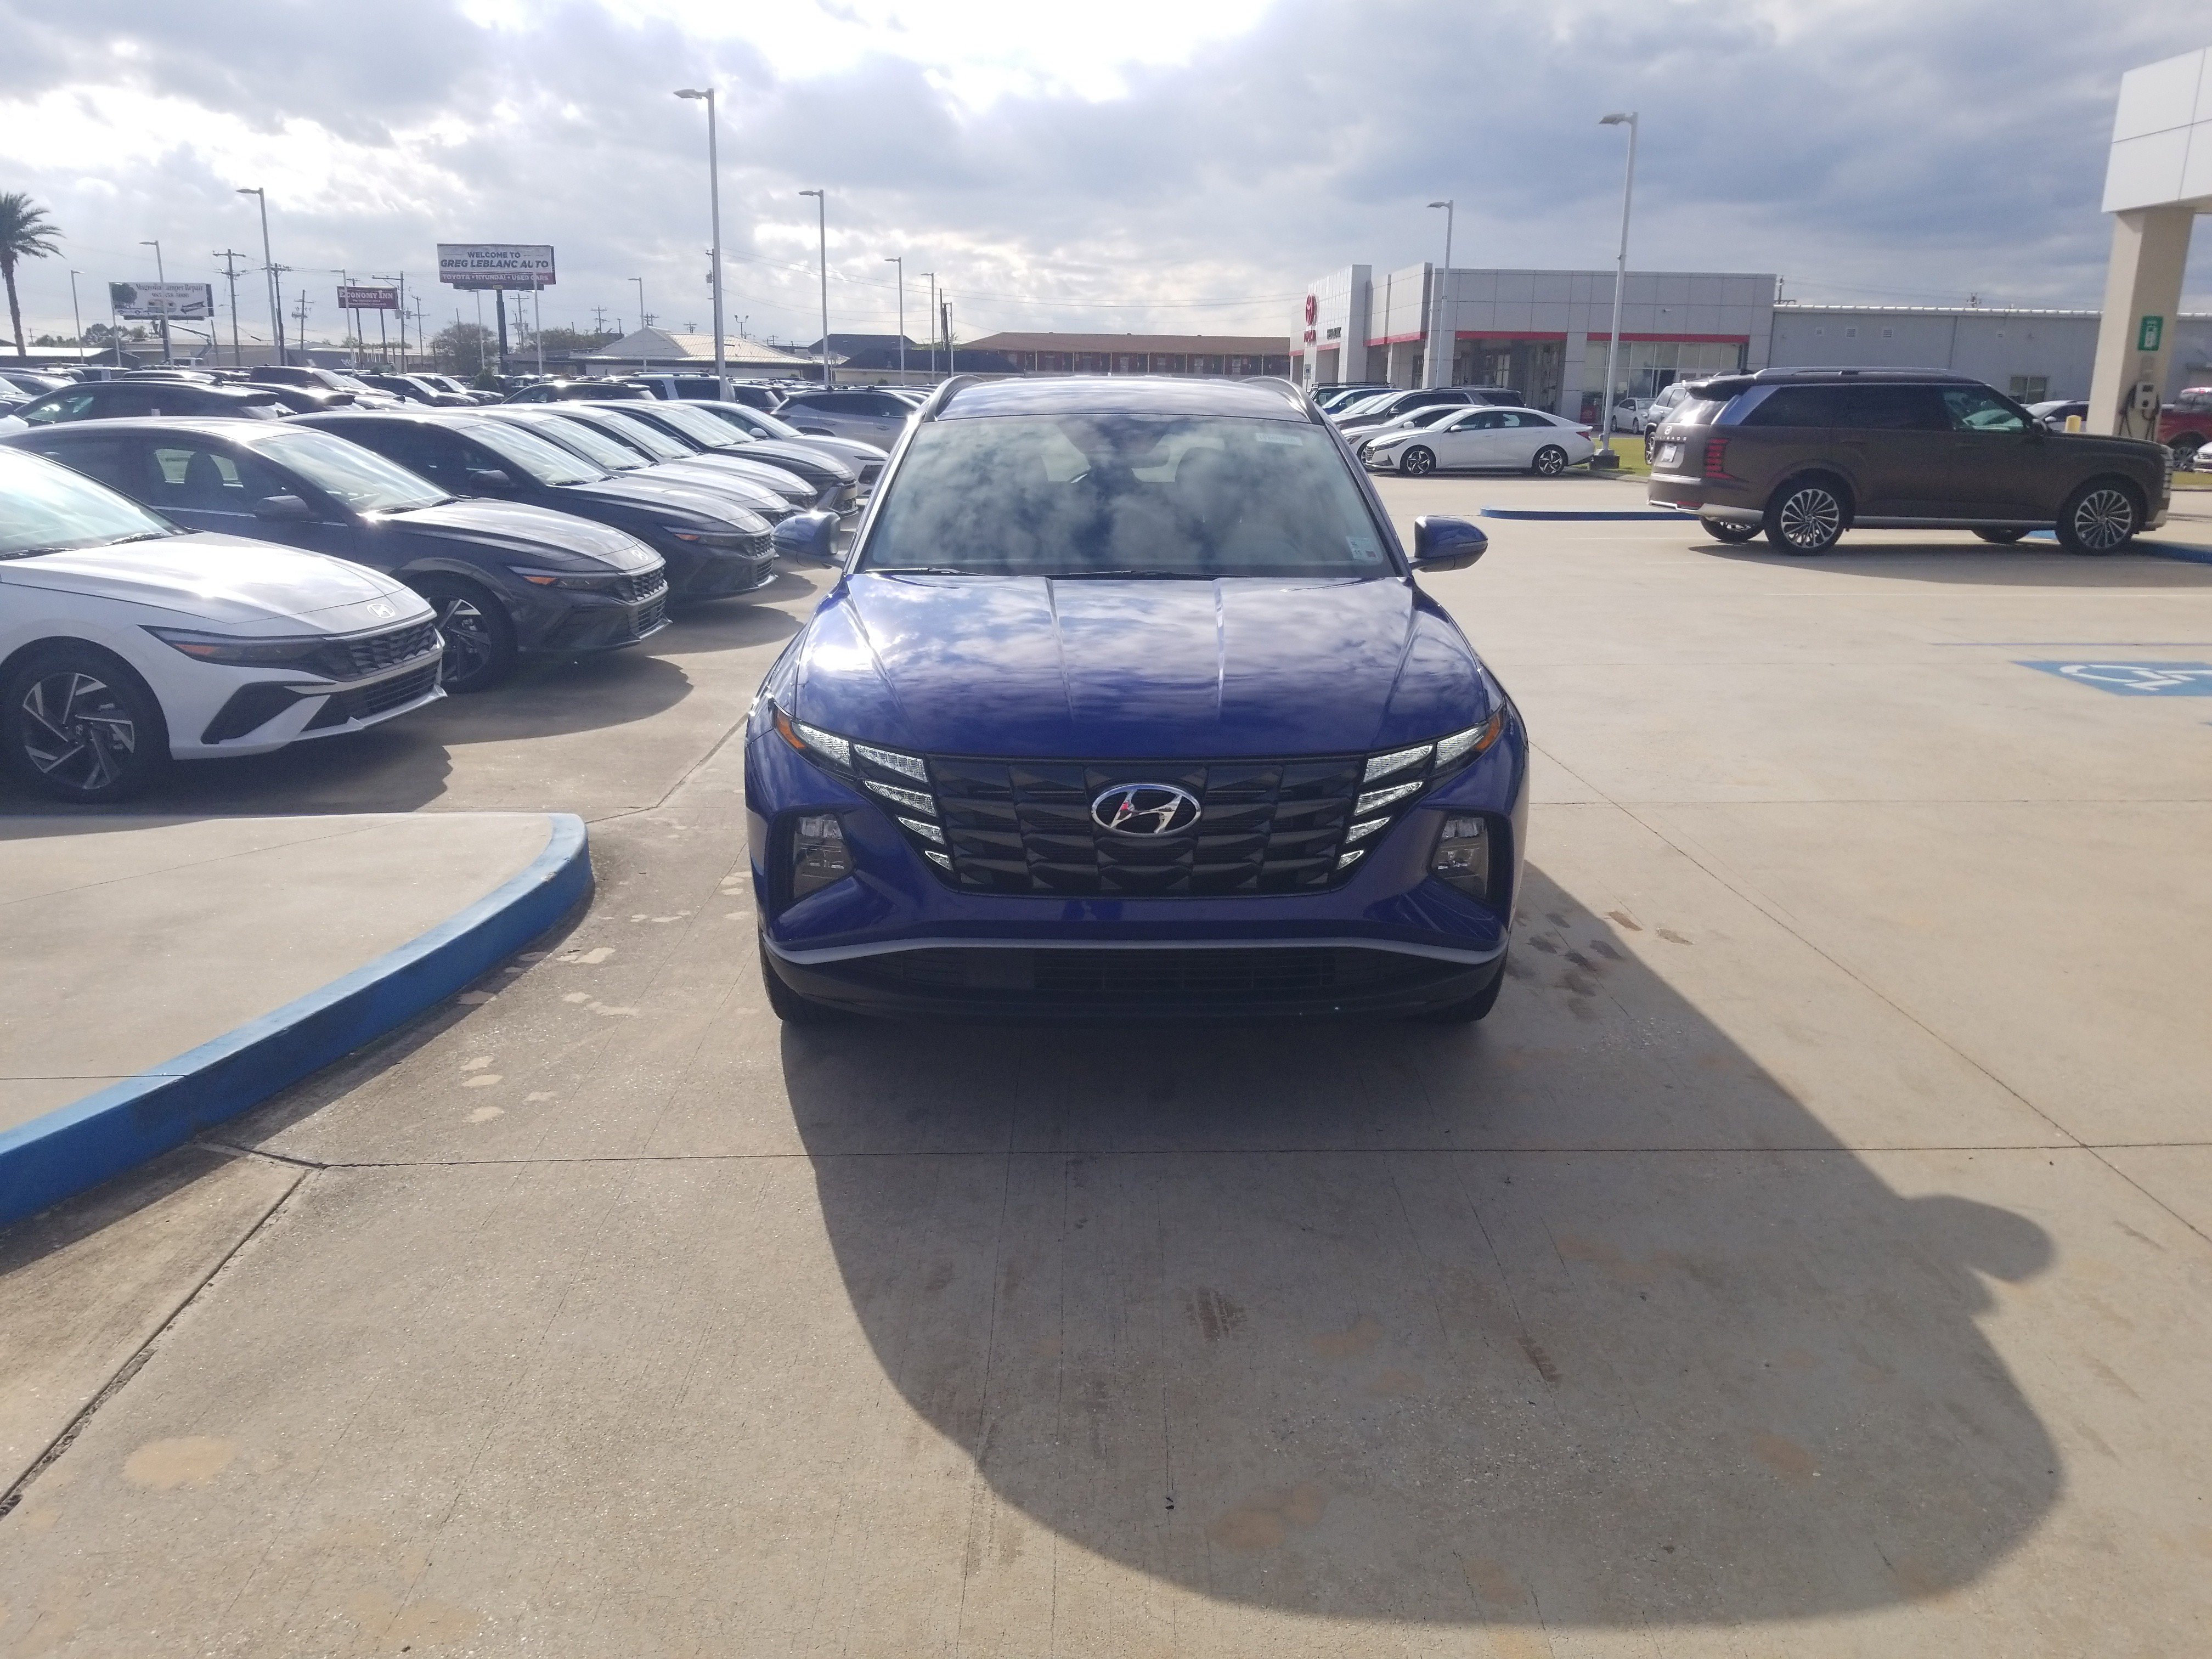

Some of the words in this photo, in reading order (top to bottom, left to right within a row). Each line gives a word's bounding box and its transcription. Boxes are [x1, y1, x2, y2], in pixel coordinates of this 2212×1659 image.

[441, 259, 468, 268] GREG
[470, 259, 518, 268] LEBLANC
[163, 284, 183, 292] amper
[185, 284, 203, 292] Repair
[338, 289, 377, 298] ECONOMY
